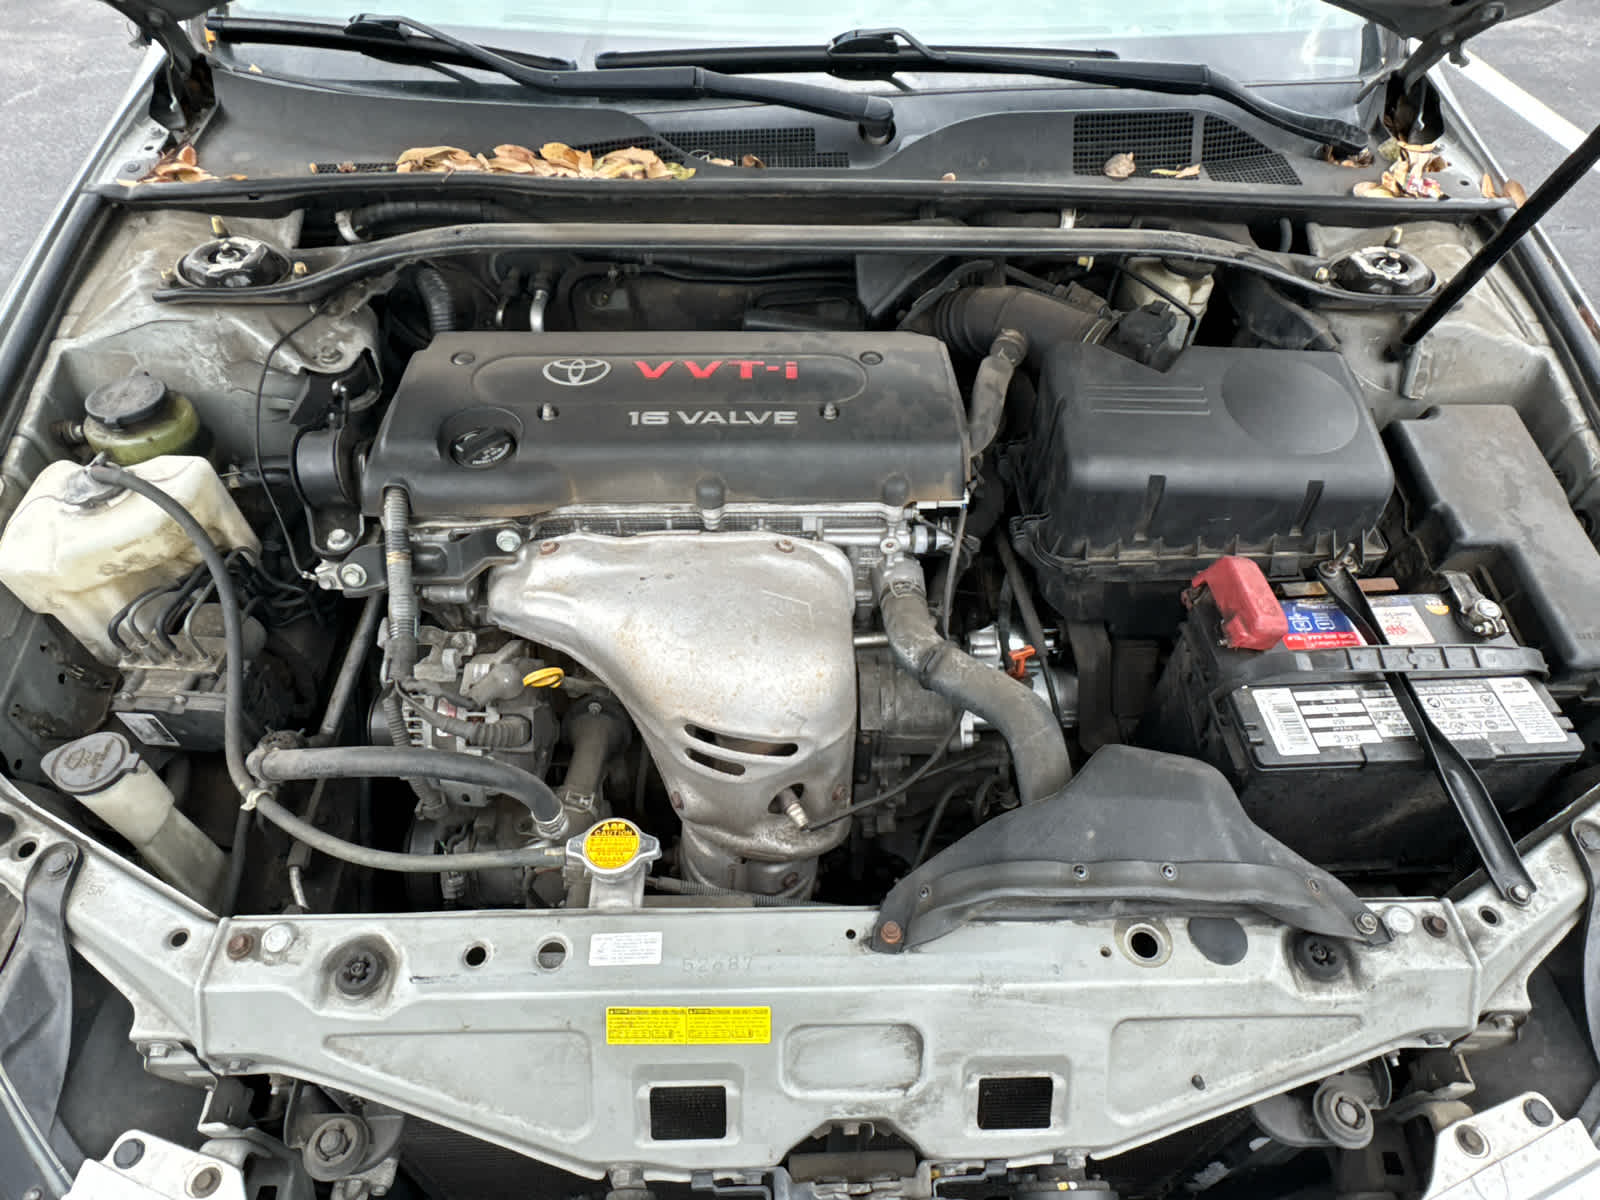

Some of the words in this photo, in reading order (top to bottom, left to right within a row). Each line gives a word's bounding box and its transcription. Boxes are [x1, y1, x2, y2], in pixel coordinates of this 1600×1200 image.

[634, 360, 799, 380] VVT-i
[628, 411, 671, 426] 16
[676, 411, 799, 425] VALVE
